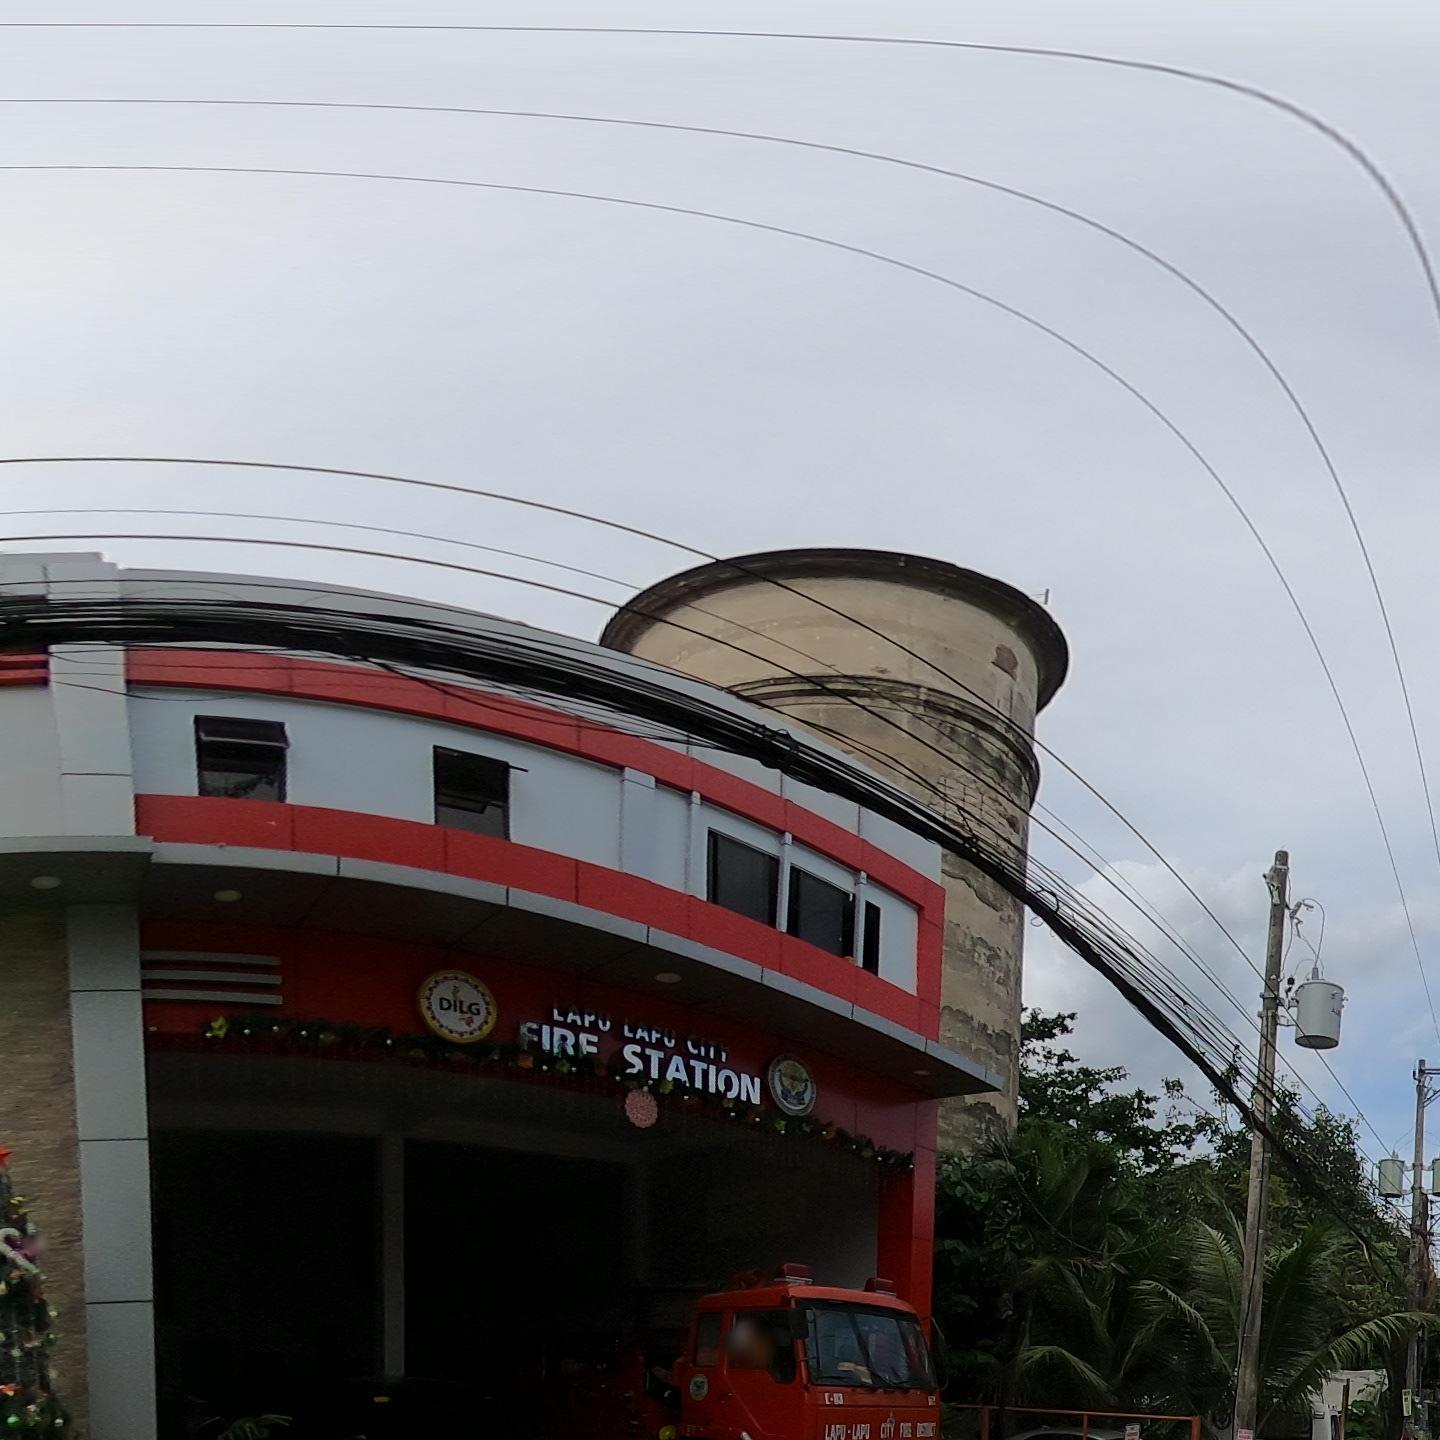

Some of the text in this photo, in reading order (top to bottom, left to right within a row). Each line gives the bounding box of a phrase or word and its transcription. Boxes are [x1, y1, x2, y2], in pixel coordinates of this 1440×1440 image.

[439, 997, 481, 1016] DILG
[552, 1001, 730, 1064] LAPU LAPU CITY
[518, 1019, 762, 1106] FIRE STATION
[880, 1422, 895, 1439] CITY
